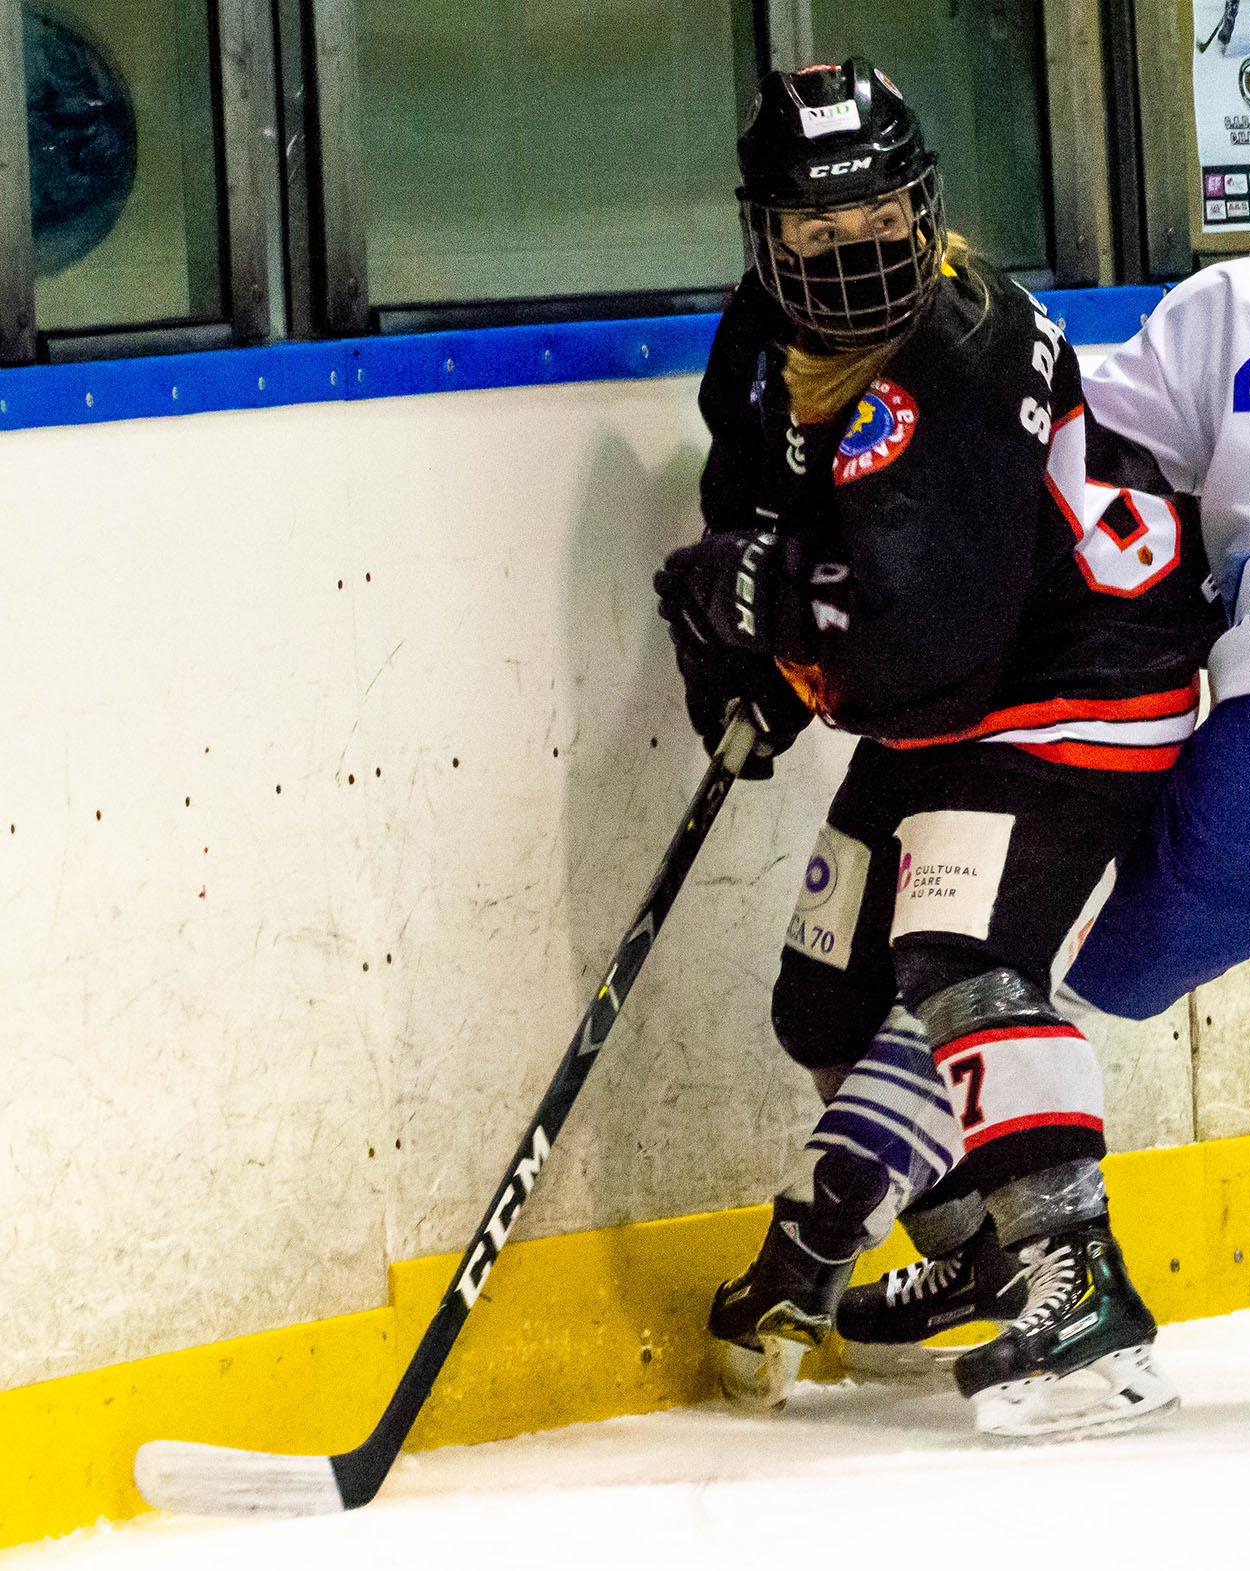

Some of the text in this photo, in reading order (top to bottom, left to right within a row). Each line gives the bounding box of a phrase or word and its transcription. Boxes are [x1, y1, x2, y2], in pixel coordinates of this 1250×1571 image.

[809, 157, 873, 179] CCM
[915, 864, 978, 877] CULTURAL
[913, 876, 942, 888] CARE
[911, 888, 956, 899] AU PAIR
[811, 925, 835, 954] 70
[453, 1124, 551, 1310] CCM
